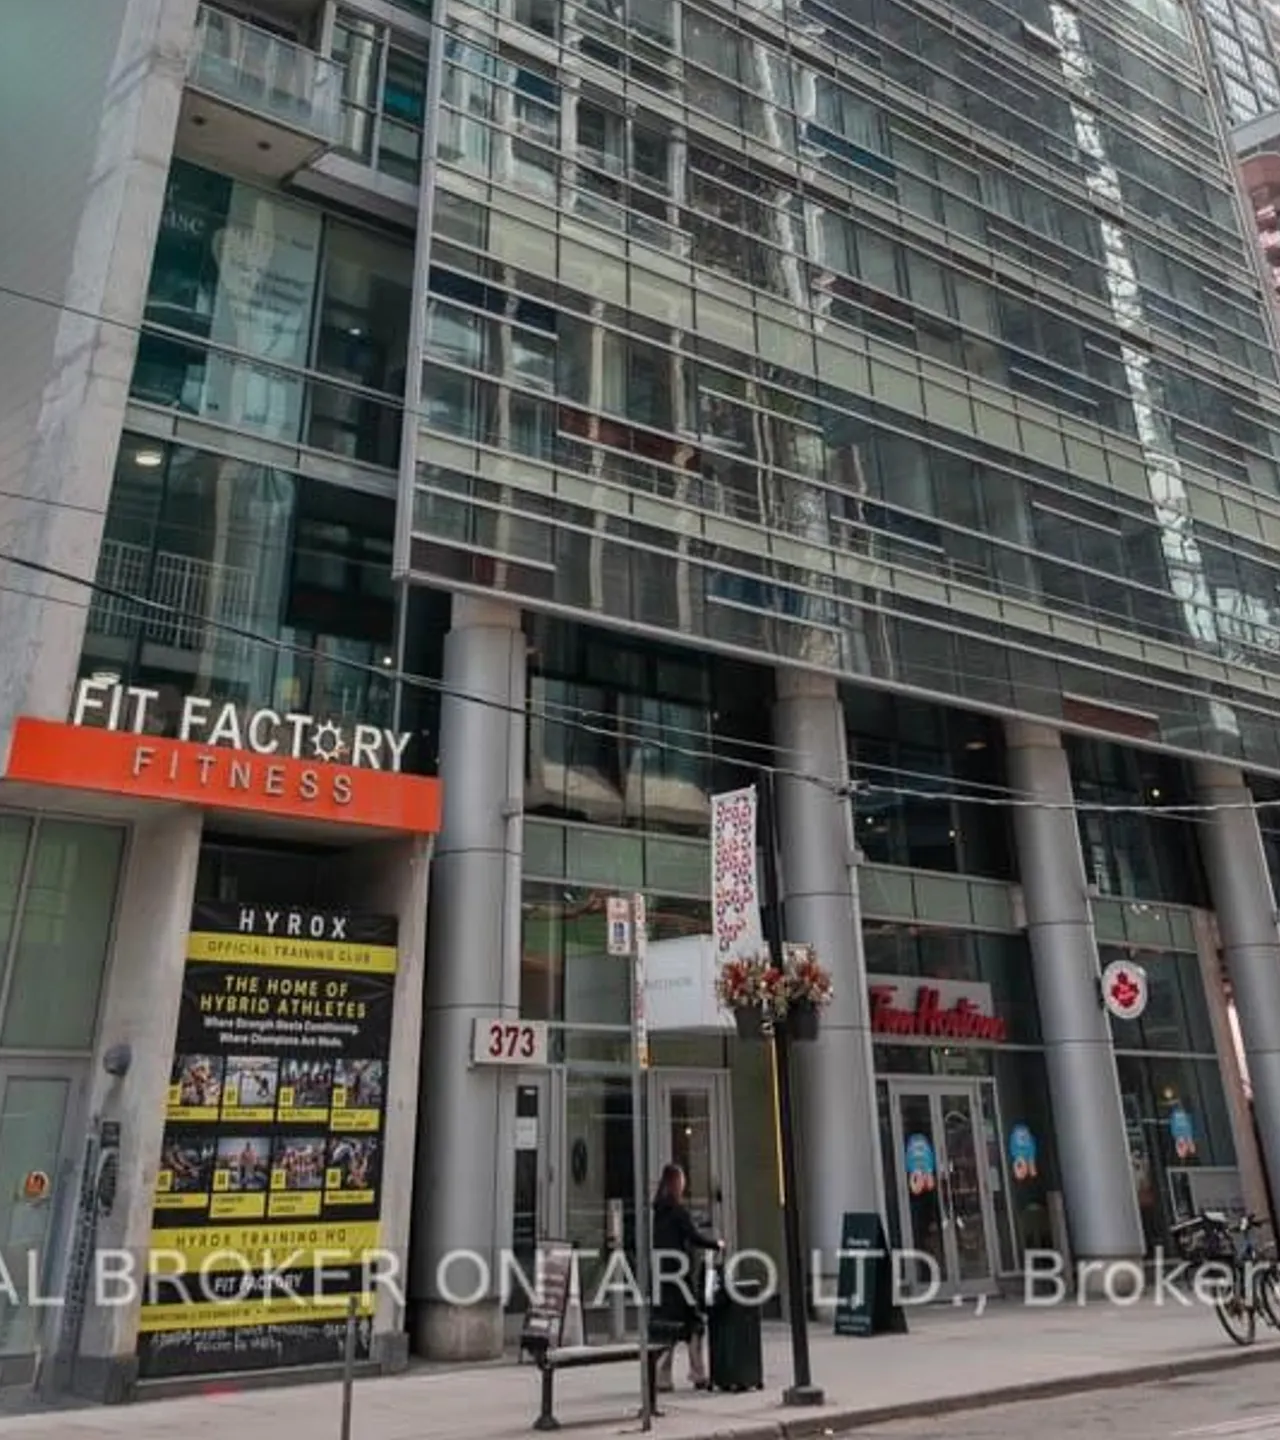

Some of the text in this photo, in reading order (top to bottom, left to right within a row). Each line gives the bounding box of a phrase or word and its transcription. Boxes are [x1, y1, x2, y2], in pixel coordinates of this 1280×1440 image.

[74, 678, 412, 773] FIT FACTORY
[133, 747, 353, 805] FITNESS
[238, 908, 347, 939] HYROX
[207, 940, 371, 964] OFFICIAL TRAINING CLUB
[224, 975, 350, 998] THE HOME OF
[199, 993, 366, 1019] HYBRID ATHLETES
[489, 1025, 535, 1057] 373
[176, 1228, 347, 1248] HYROX TRAINING HQ
